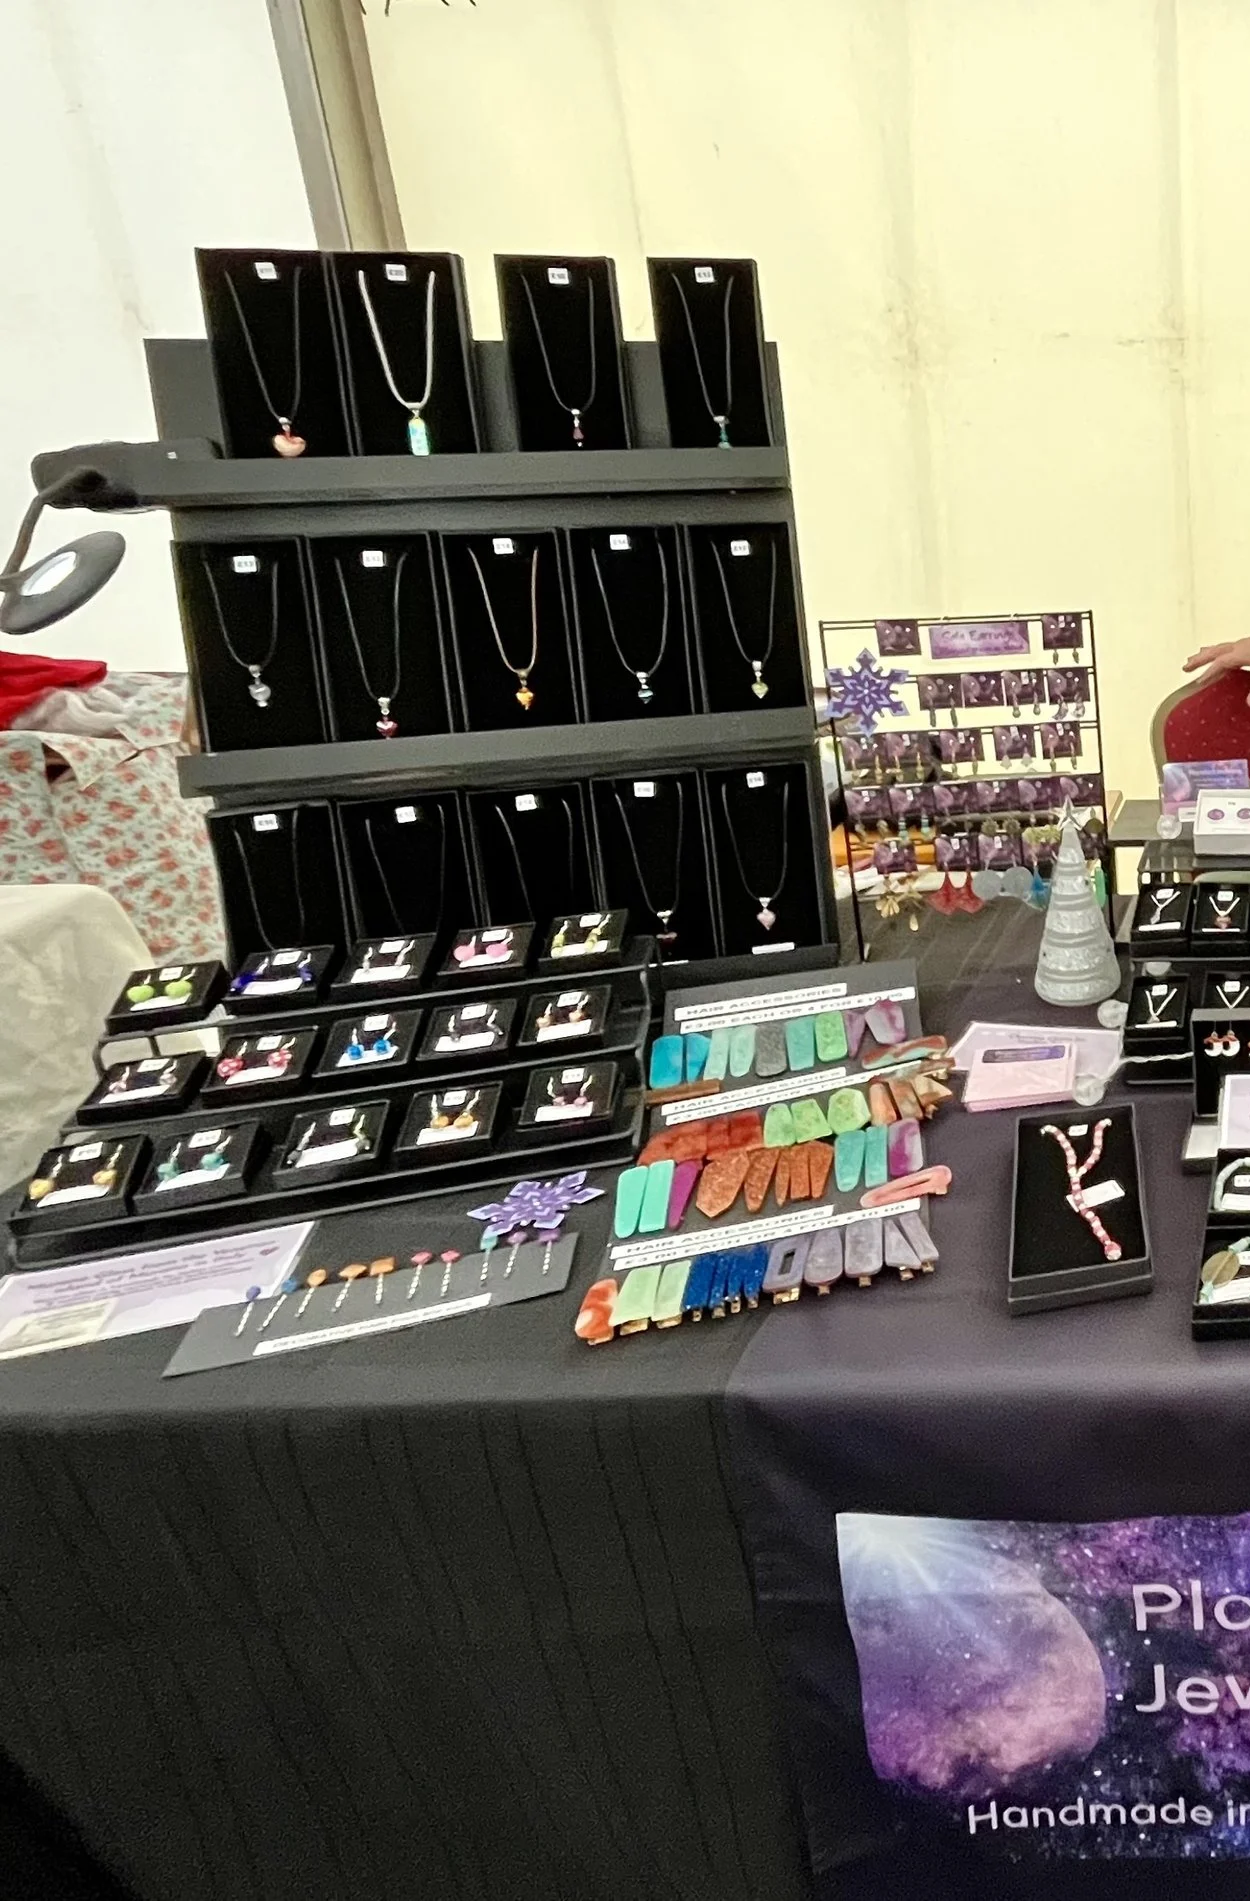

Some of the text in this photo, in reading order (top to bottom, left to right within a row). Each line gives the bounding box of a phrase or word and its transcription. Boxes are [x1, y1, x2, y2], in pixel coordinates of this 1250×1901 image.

[687, 987, 842, 1015] HAIR ACCESSORIES
[731, 1012, 775, 1024] EACH
[780, 1007, 802, 1015] OR
[820, 999, 852, 1009] FOR
[627, 1210, 825, 1253] HAIR ACCESSORIES
[685, 1239, 741, 1254] EACH
[967, 1797, 1213, 1835] Handmade
